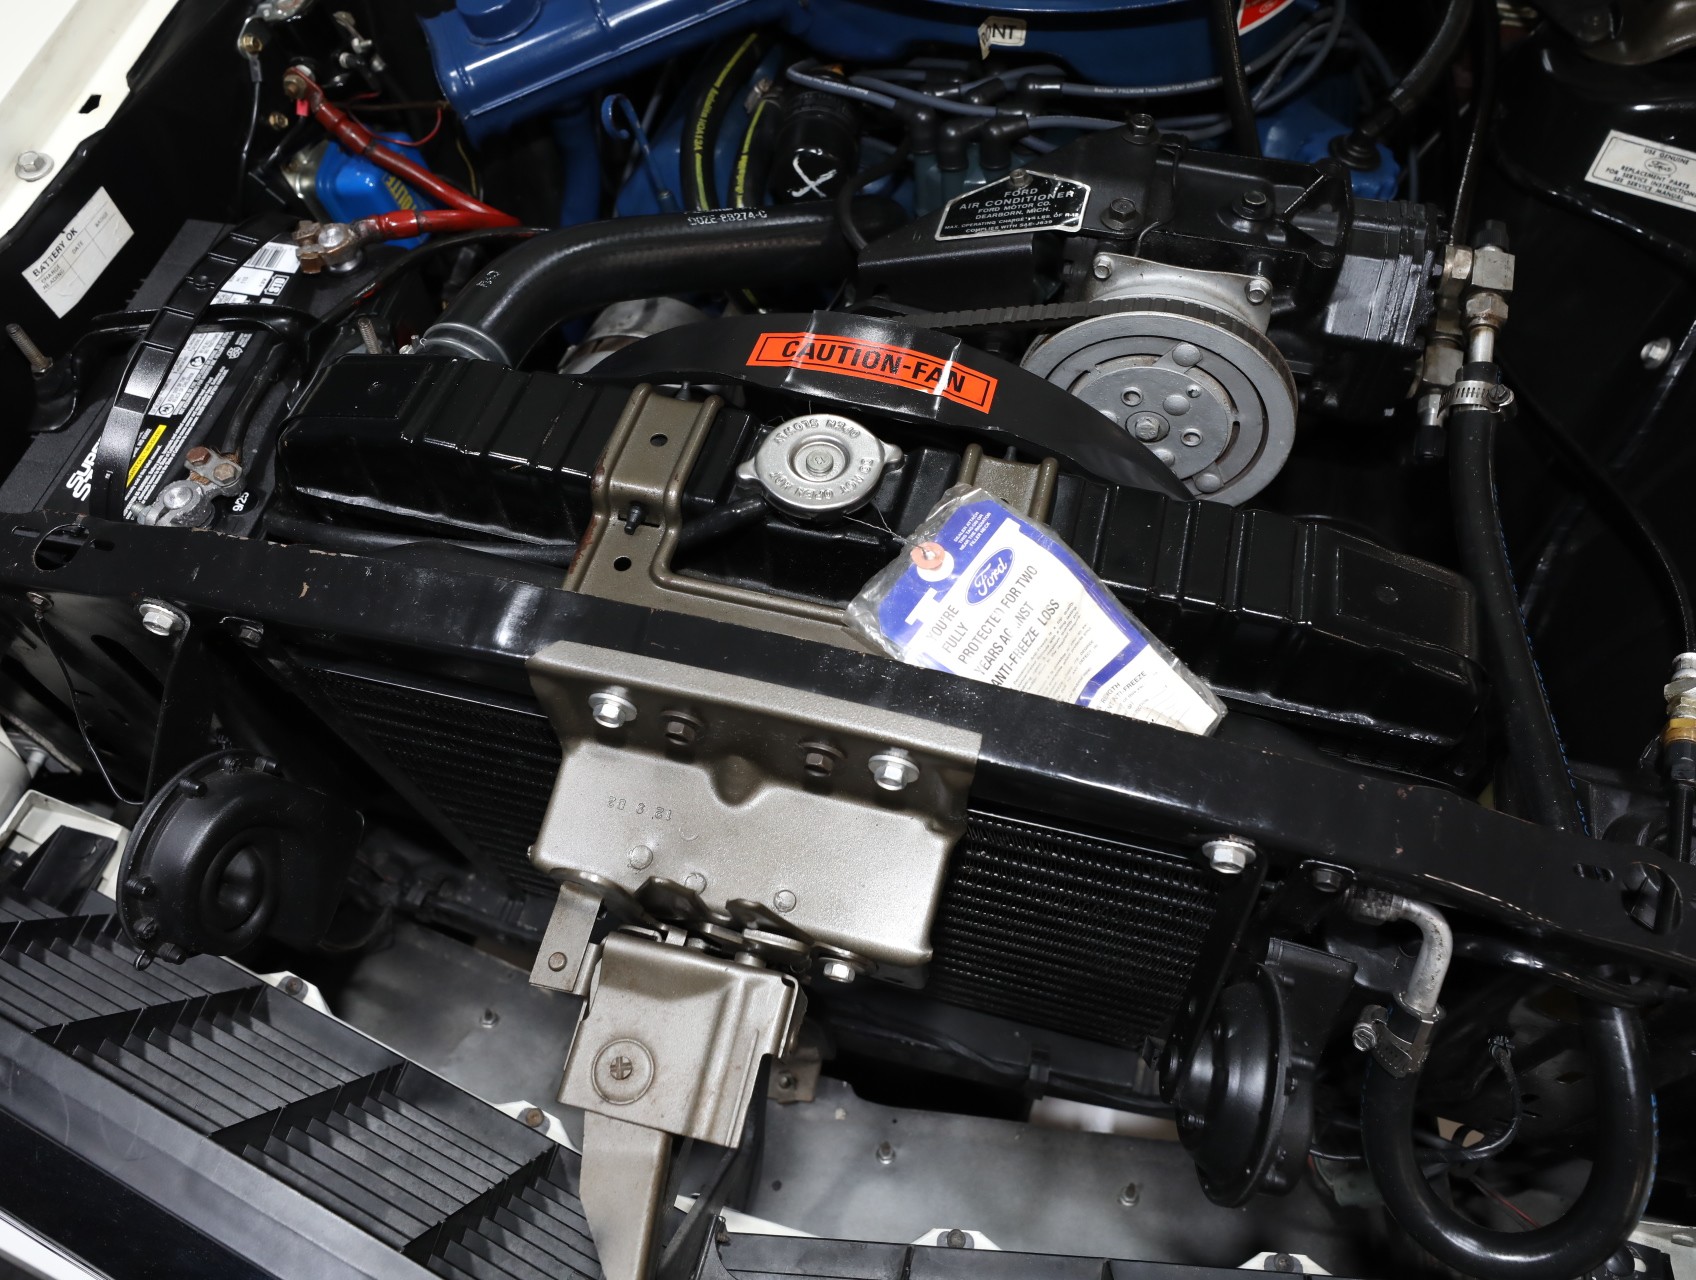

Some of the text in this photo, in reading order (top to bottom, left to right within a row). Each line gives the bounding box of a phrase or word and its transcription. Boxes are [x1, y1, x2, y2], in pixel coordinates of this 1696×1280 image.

[1659, 153, 1689, 165] GENUINE
[1605, 167, 1619, 175] FOR
[1622, 172, 1648, 183] SERVICE
[1621, 165, 1690, 189] REPLACEMENT PARTS
[959, 190, 1074, 210] AIR CONDITIONER
[1003, 188, 1038, 198] FORD
[1627, 181, 1653, 191] SERVICE
[1656, 188, 1684, 201] MANUAL
[961, 220, 997, 228] OPERATING
[965, 225, 999, 233] COMPLIES
[32, 227, 78, 277] BATTERY OK
[794, 487, 834, 500] OPEN
[839, 475, 864, 495] NOT
[973, 557, 1008, 597] Ford
[1000, 586, 1022, 609] FOR
[1015, 565, 1038, 590] TWO
[925, 604, 960, 641] YOU'RE
[941, 621, 969, 654] FULLY
[990, 626, 1040, 686] ANTI-FREEZE
[1037, 598, 1060, 627] LOSS
[974, 641, 1004, 676] YEARS
